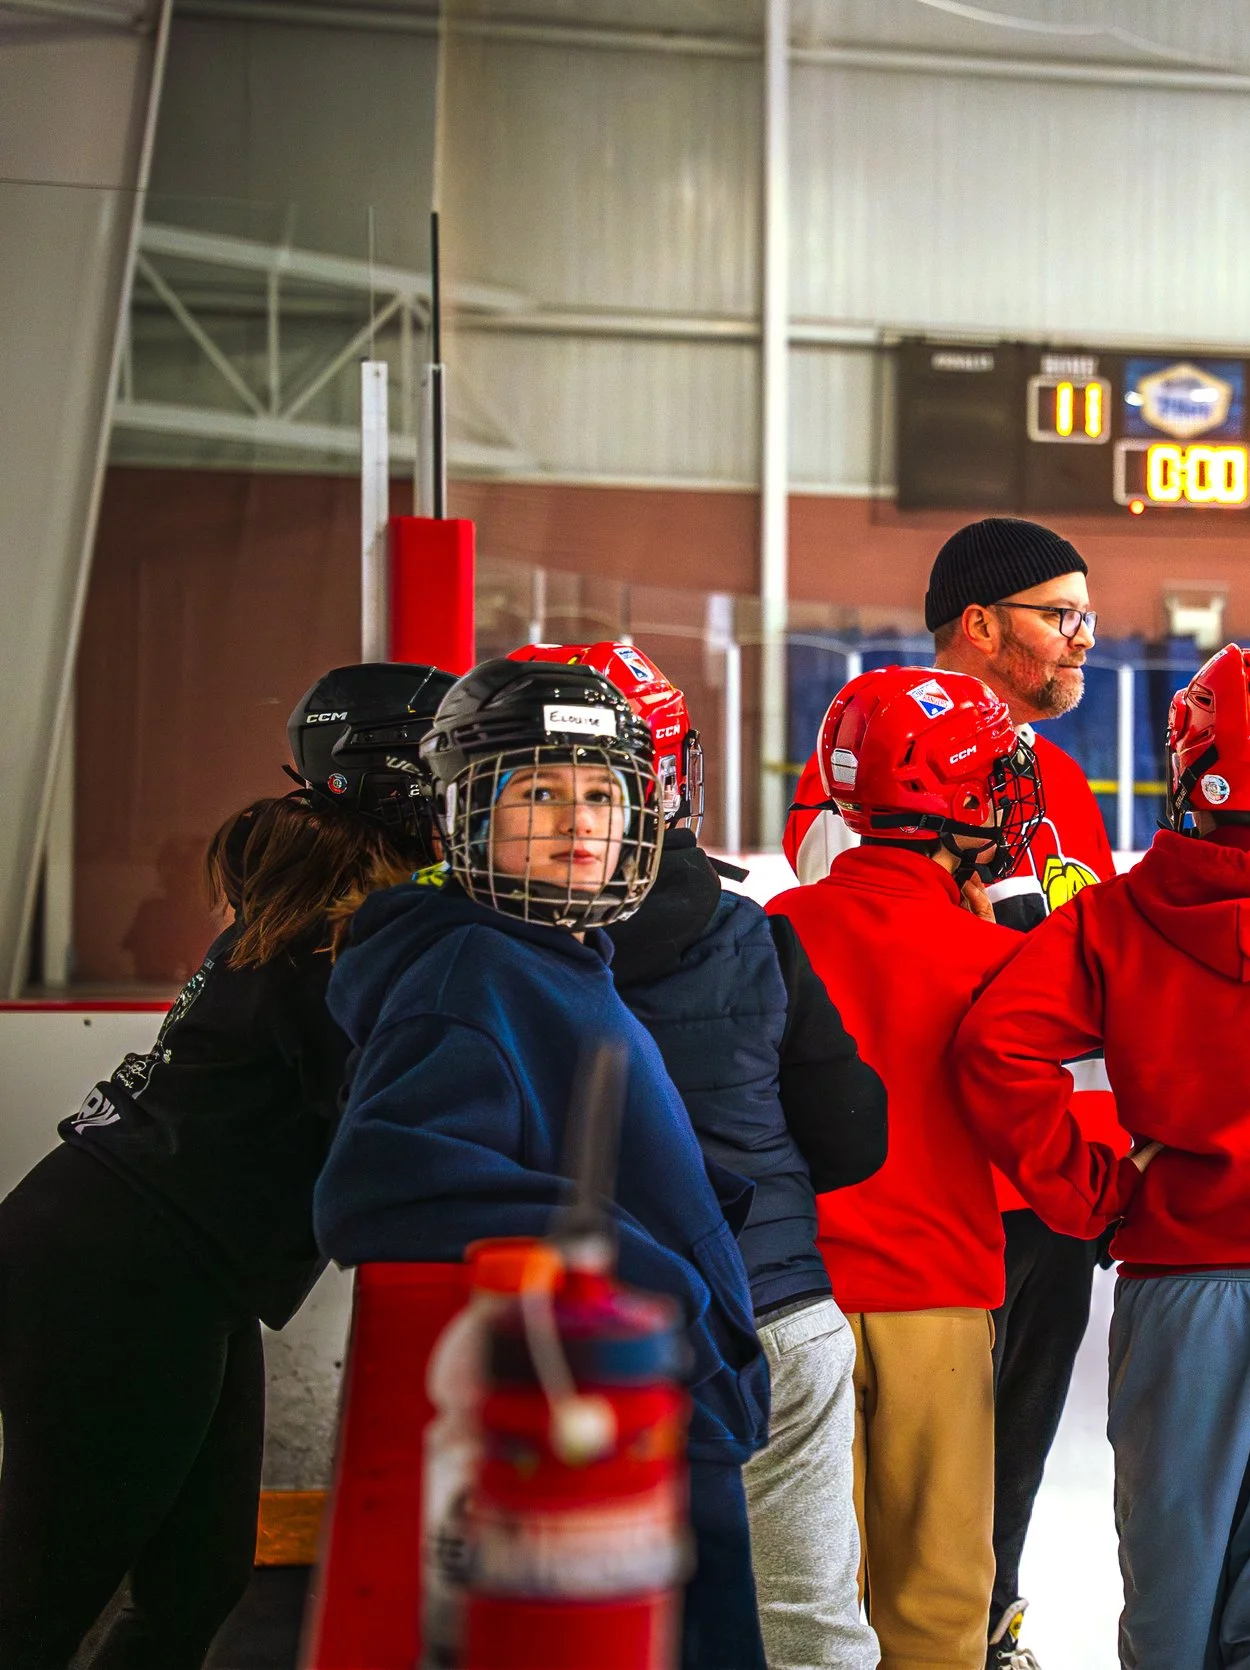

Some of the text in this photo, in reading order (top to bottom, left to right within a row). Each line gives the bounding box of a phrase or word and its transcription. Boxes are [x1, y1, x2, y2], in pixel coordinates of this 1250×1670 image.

[1055, 382, 1102, 438] 11
[1147, 443, 1248, 504] 0:00
[305, 711, 348, 724] CCM
[949, 745, 977, 764] CCM
